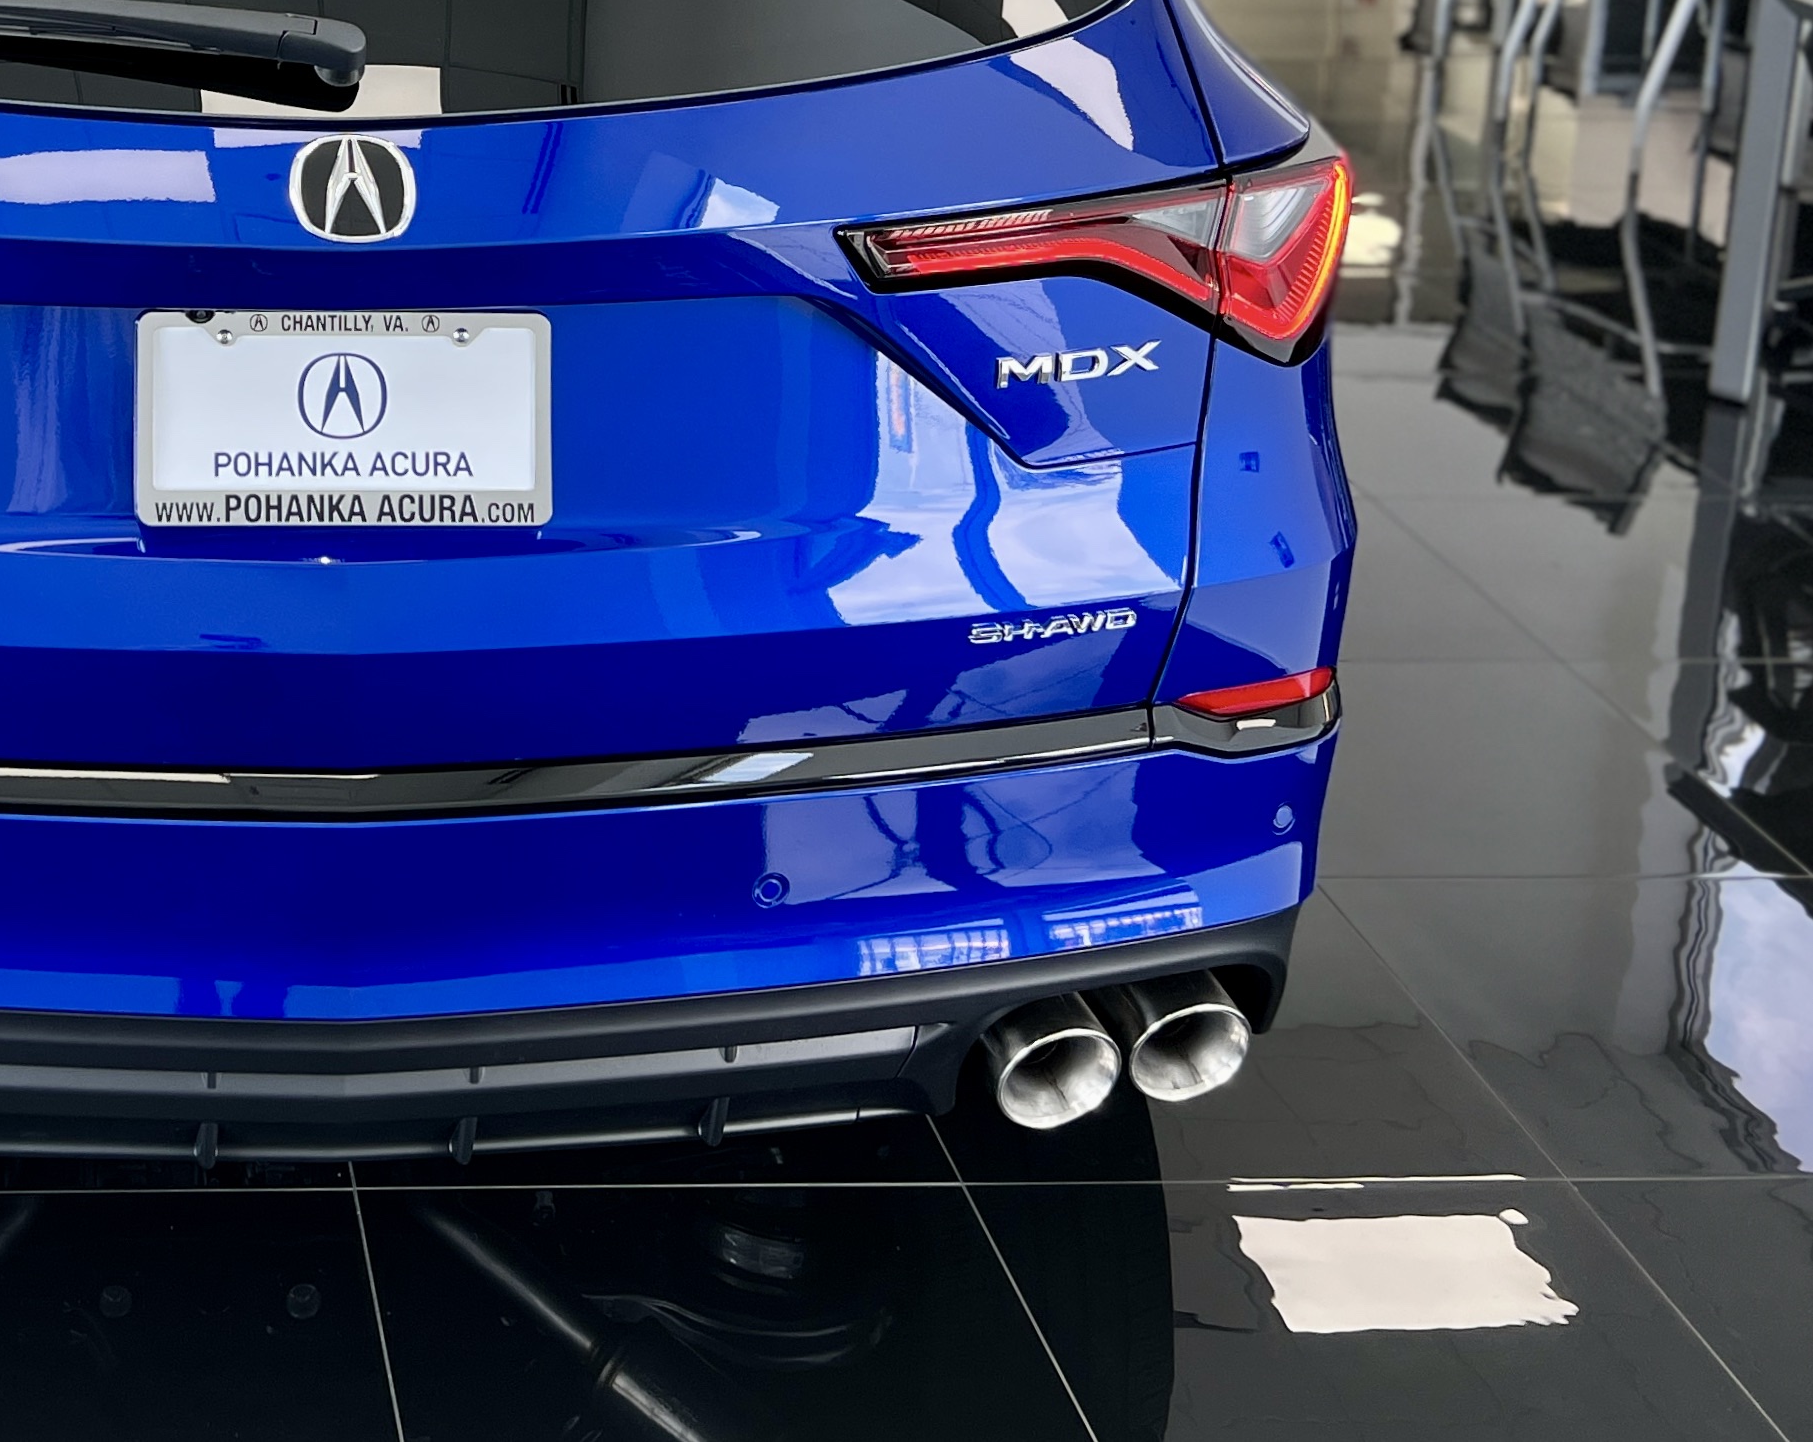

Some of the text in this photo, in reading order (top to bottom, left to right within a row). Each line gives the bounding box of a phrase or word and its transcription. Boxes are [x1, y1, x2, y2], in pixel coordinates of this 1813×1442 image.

[281, 314, 410, 333] CHANTILLY, VA.
[996, 339, 1162, 389] MDX
[214, 451, 474, 478] POHANKA ACURA
[968, 607, 1138, 645] SH-AWD
